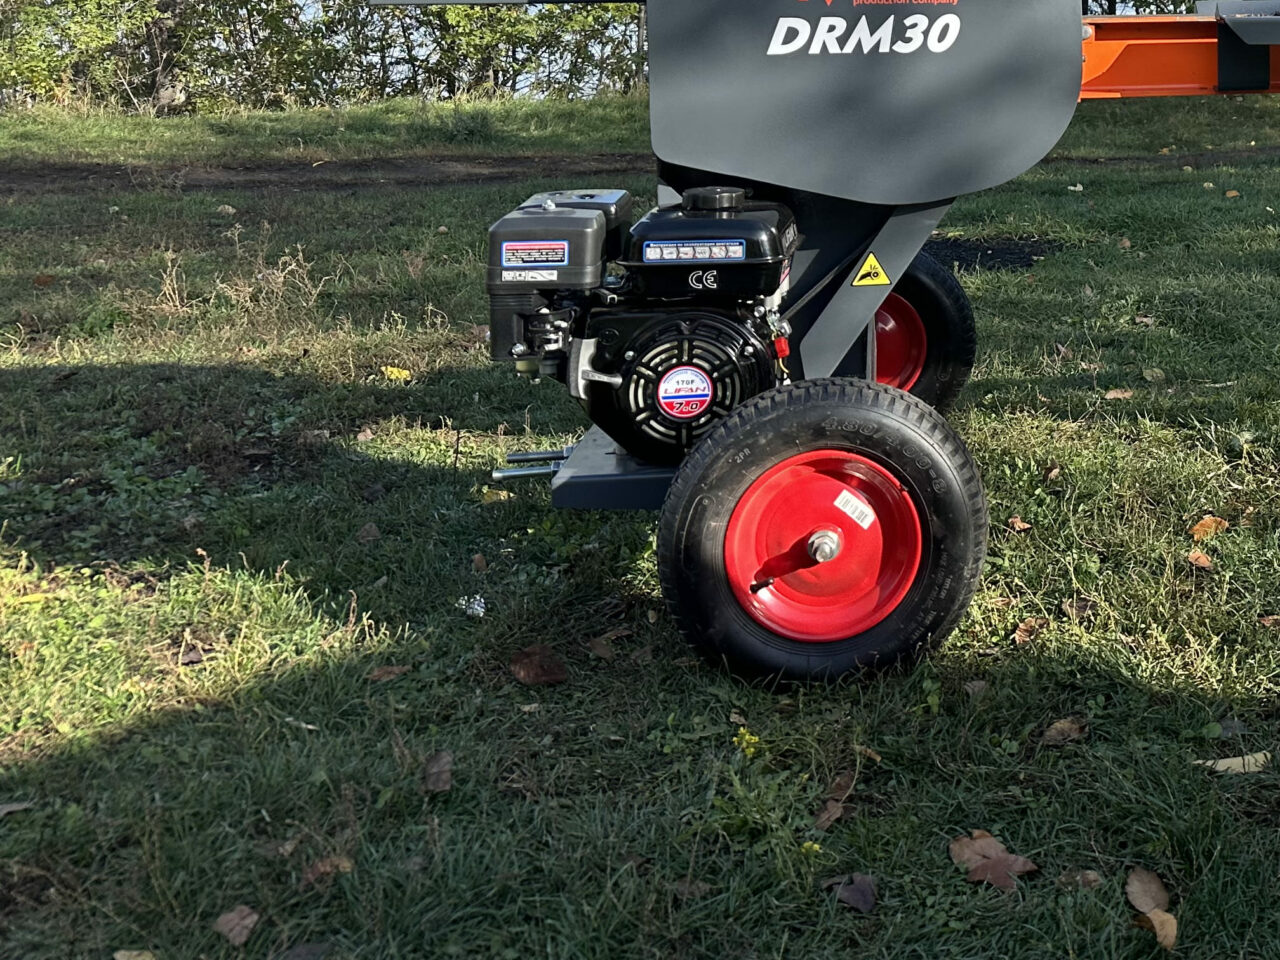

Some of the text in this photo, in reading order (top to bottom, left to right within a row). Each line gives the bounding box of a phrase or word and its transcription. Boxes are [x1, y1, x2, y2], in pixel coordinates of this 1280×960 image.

[767, 14, 961, 55] DRM30
[688, 270, 717, 289] CE
[664, 387, 707, 395] LIFAN
[672, 401, 700, 412] 7.0
